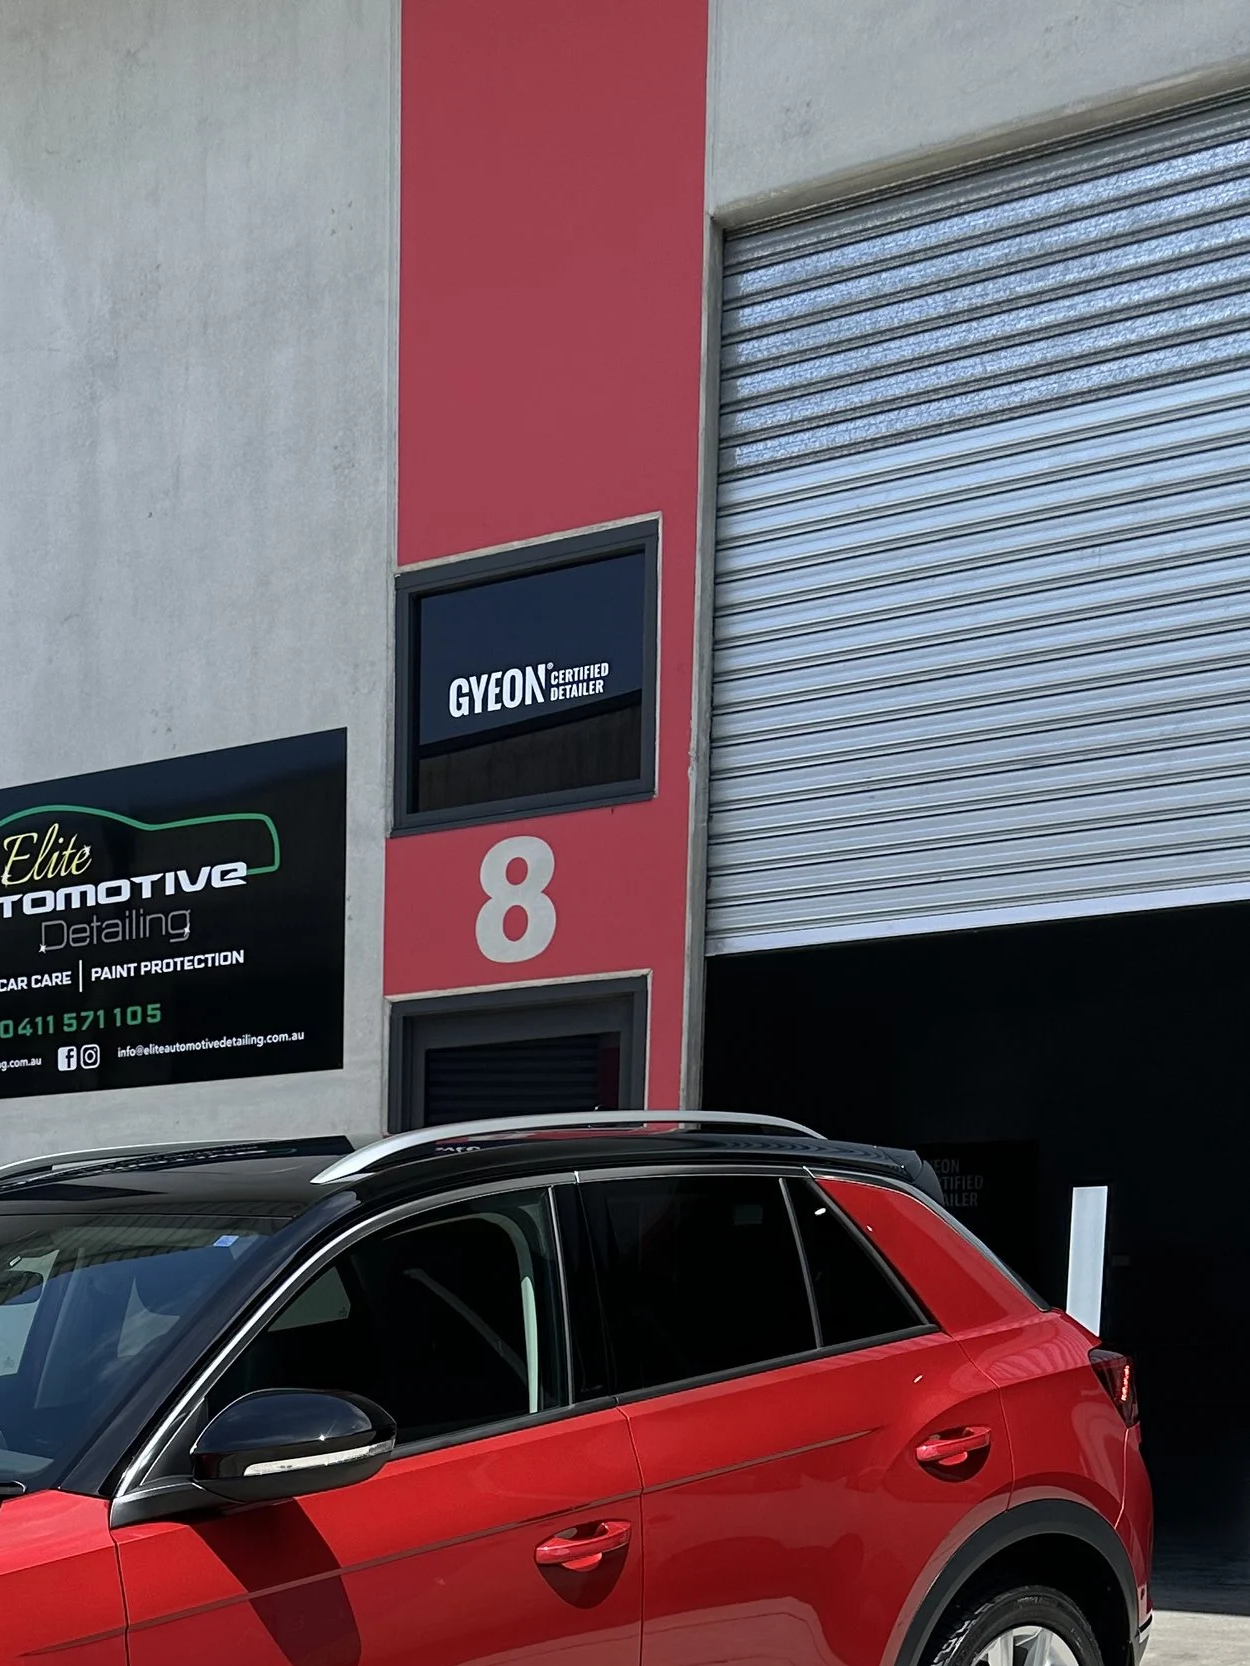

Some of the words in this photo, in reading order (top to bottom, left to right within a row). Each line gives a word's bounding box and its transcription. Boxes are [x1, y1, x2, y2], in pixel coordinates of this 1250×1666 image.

[551, 662, 609, 686] CERTIFIED
[449, 663, 546, 718] GYEON
[550, 679, 604, 702] DETAILER
[1, 822, 92, 887] Elite
[475, 835, 557, 963] 8
[40, 908, 192, 951] Detailing
[31, 971, 72, 989] CARE
[91, 963, 137, 982] PAINT
[140, 949, 245, 976] PROTECTION
[0, 1015, 54, 1039] 0411
[117, 1031, 305, 1058] info@eliteautomotivedetailing.com.au
[940, 1174, 985, 1190] TIFIED
[943, 1191, 979, 1208] AILER
